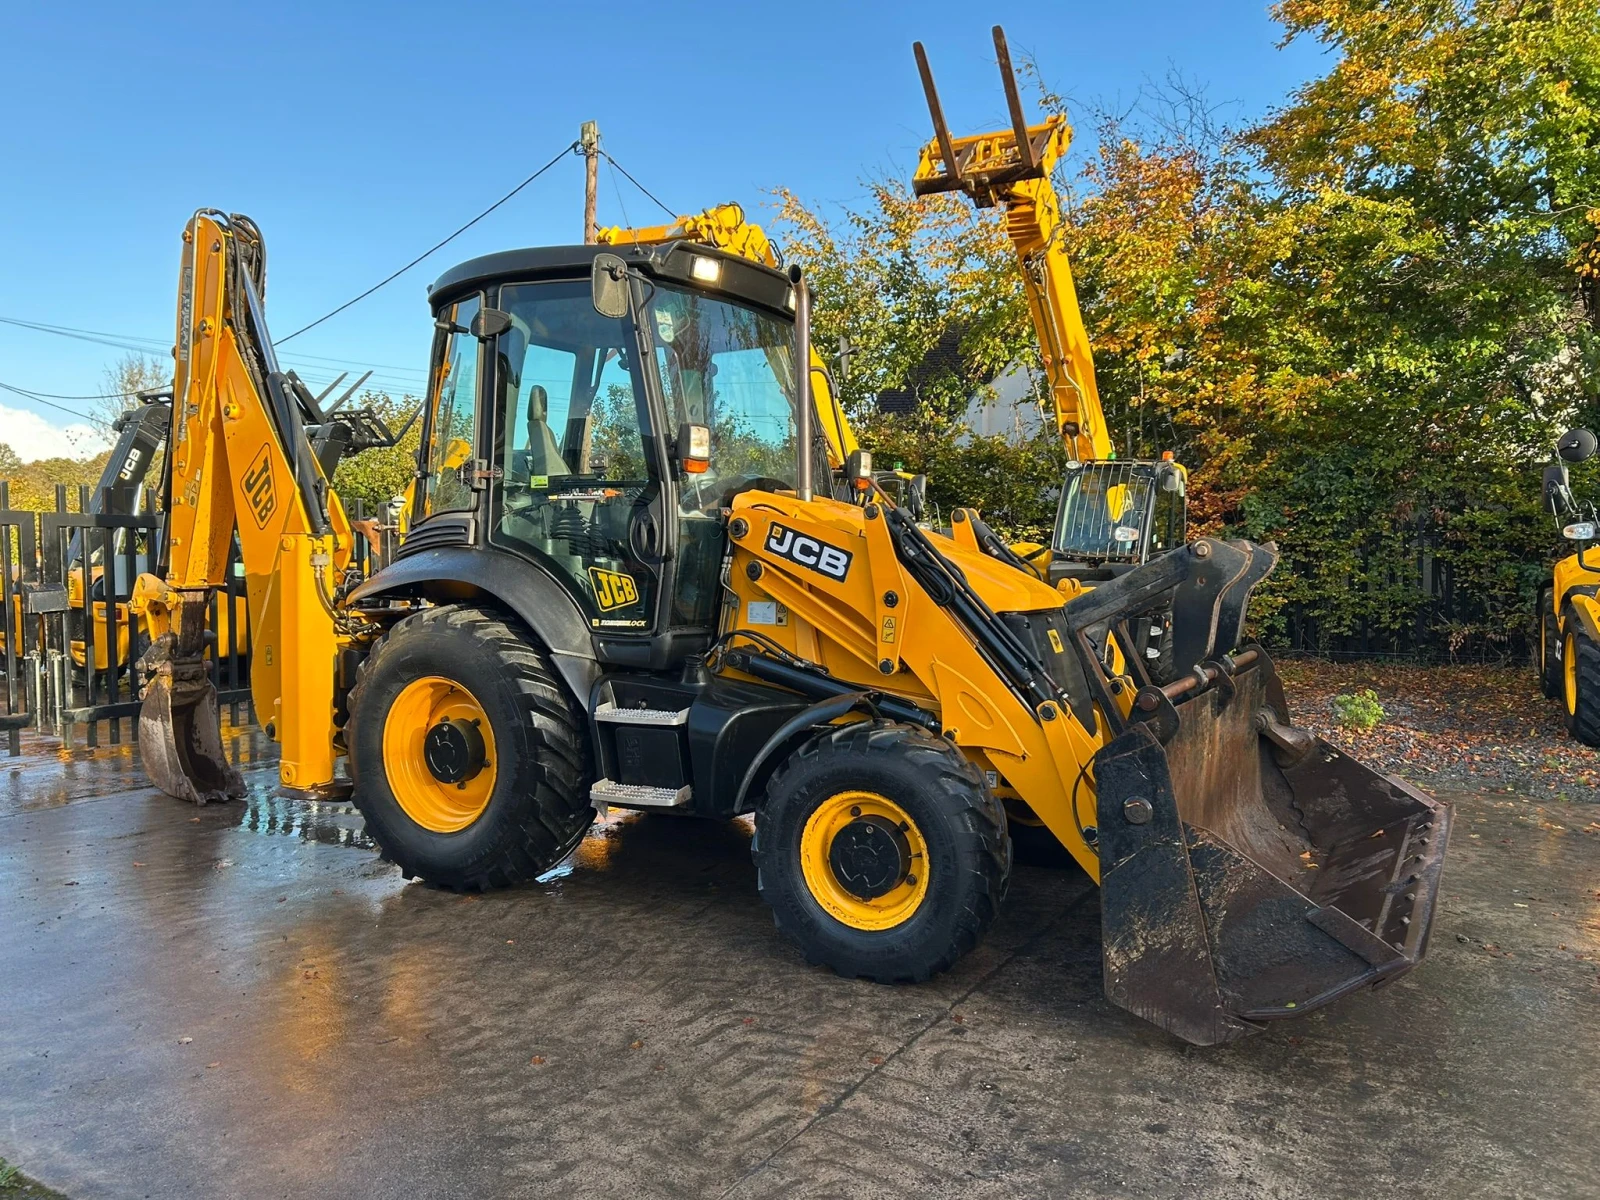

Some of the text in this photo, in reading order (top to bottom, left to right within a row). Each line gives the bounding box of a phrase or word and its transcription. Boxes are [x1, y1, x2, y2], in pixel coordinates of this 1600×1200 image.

[120, 448, 141, 480] JCB
[244, 455, 274, 523] JCB
[769, 531, 848, 577] JCB
[596, 571, 636, 607] JCB
[600, 619, 646, 627] TORLOCK
